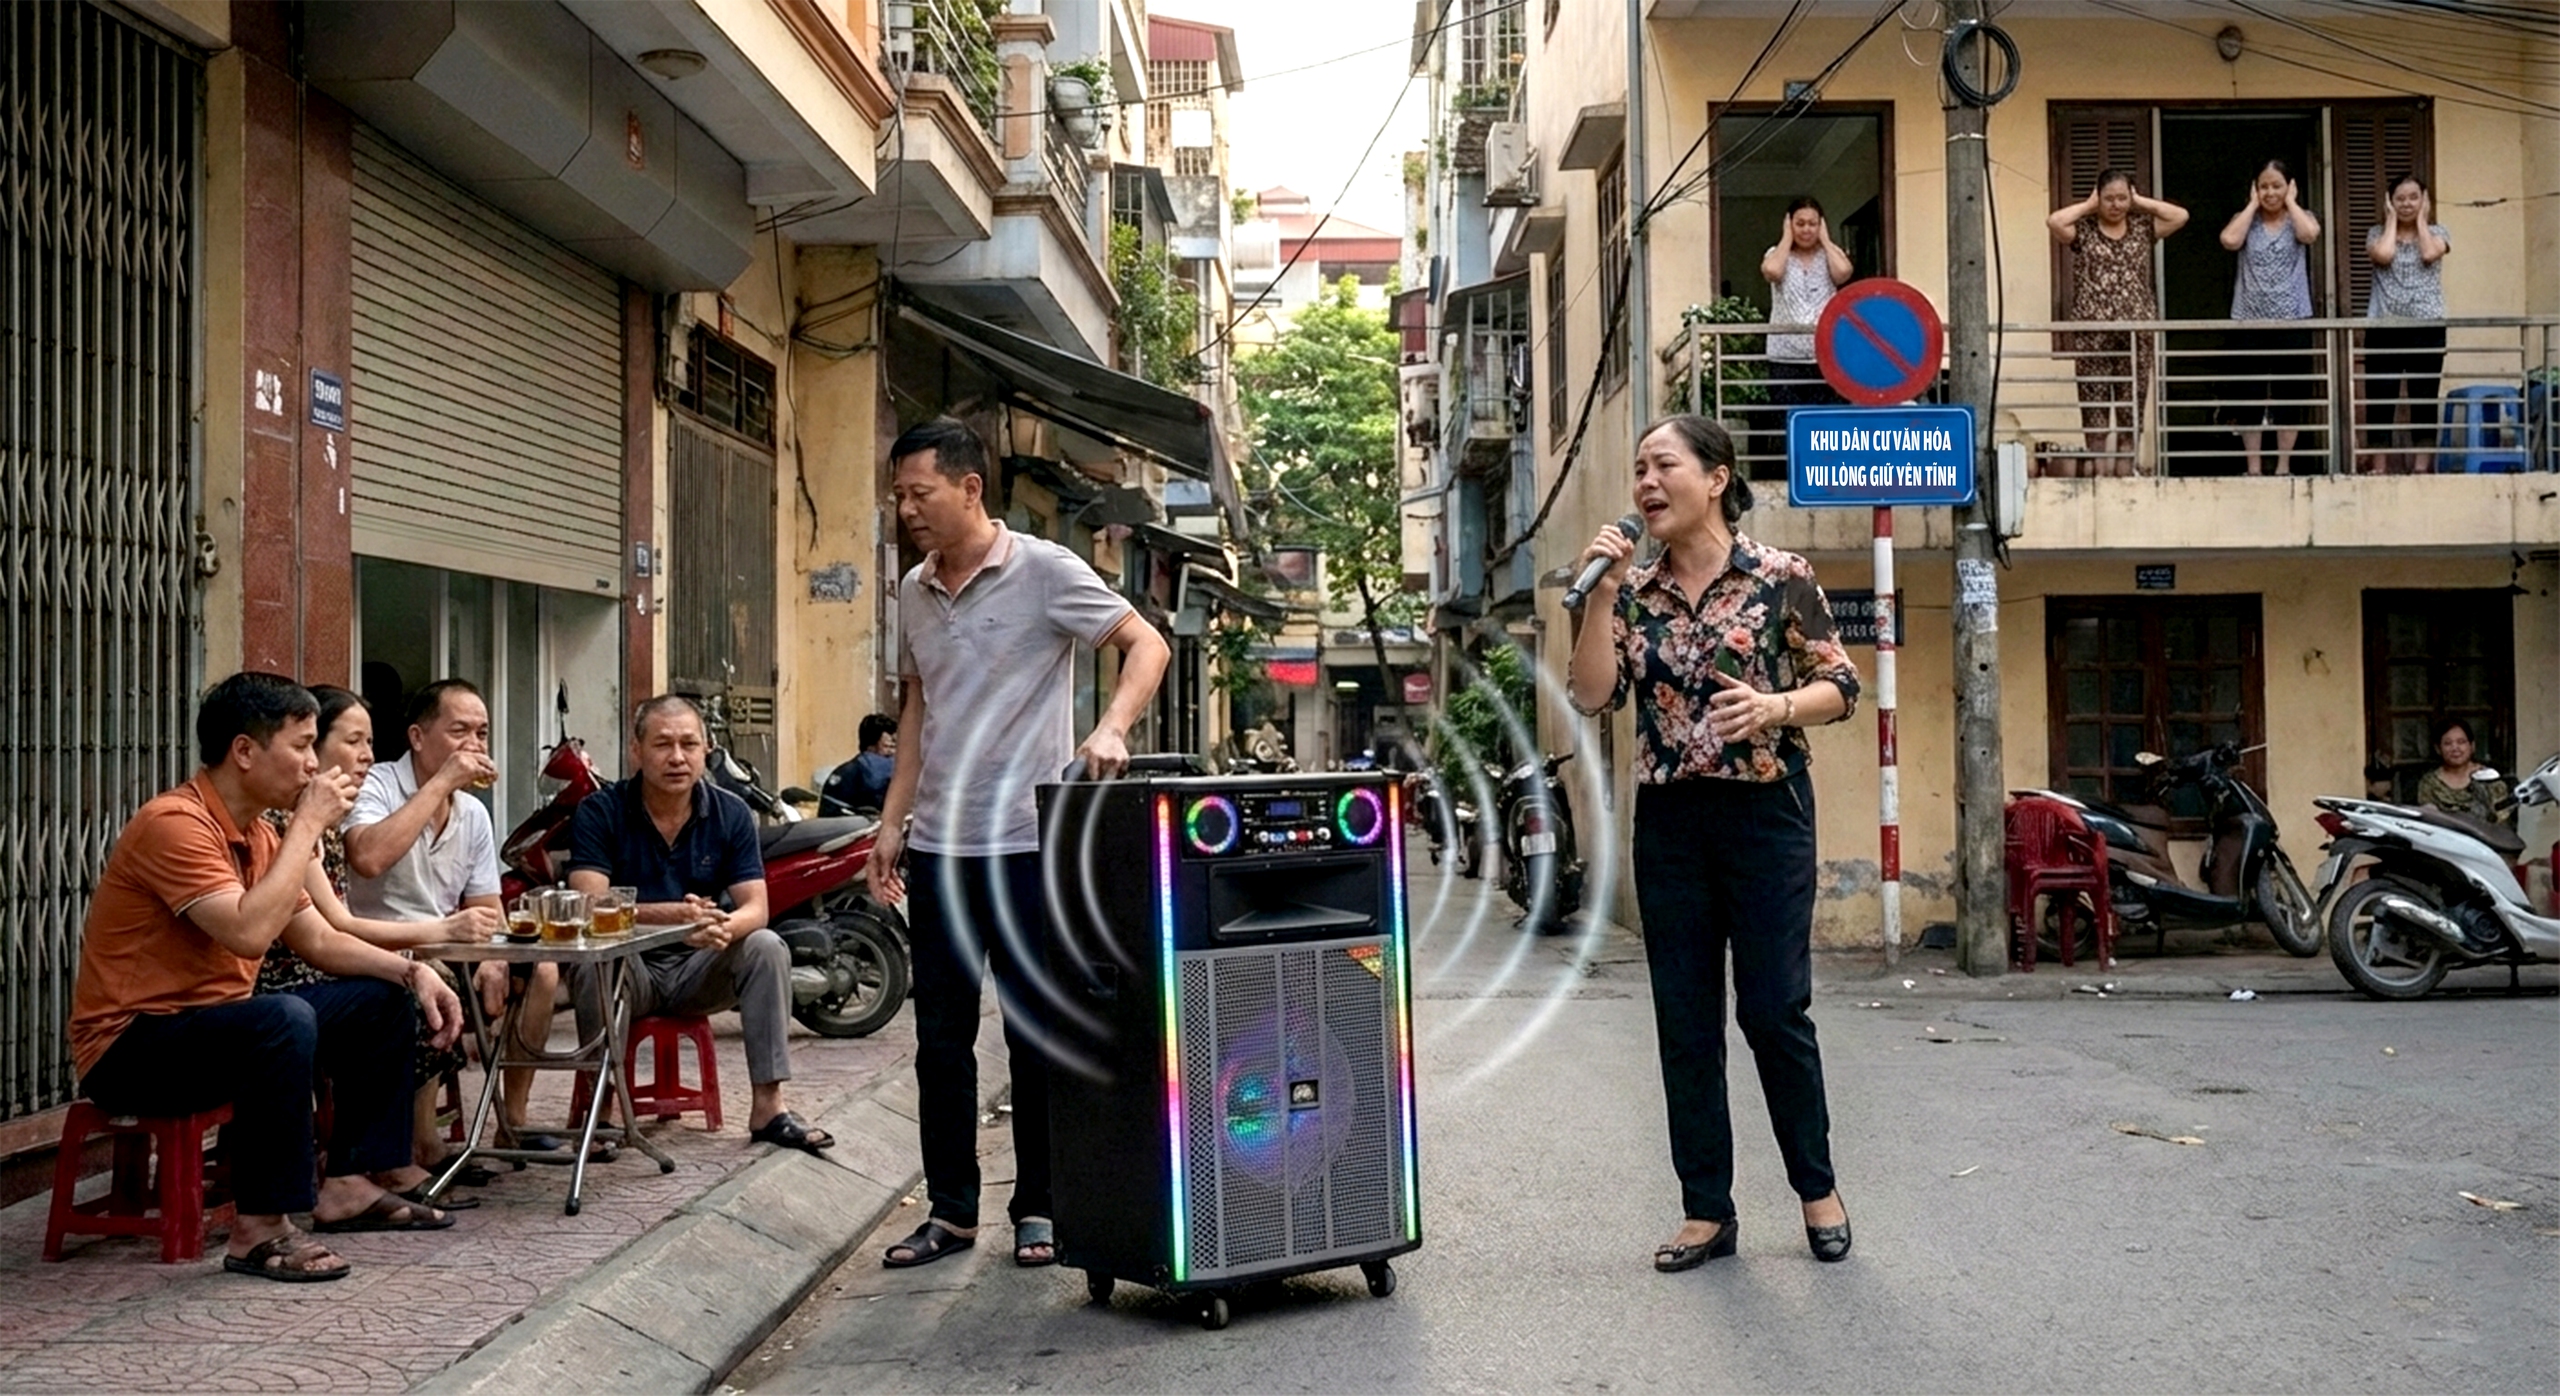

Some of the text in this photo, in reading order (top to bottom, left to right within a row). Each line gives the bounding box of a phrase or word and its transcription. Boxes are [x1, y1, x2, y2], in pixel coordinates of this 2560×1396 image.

[1810, 426, 1952, 451] KHU DÂN CƯ VĂN HÓA
[1805, 461, 1957, 487] VUI LÒNG GIỮ YÊN TĨNH
